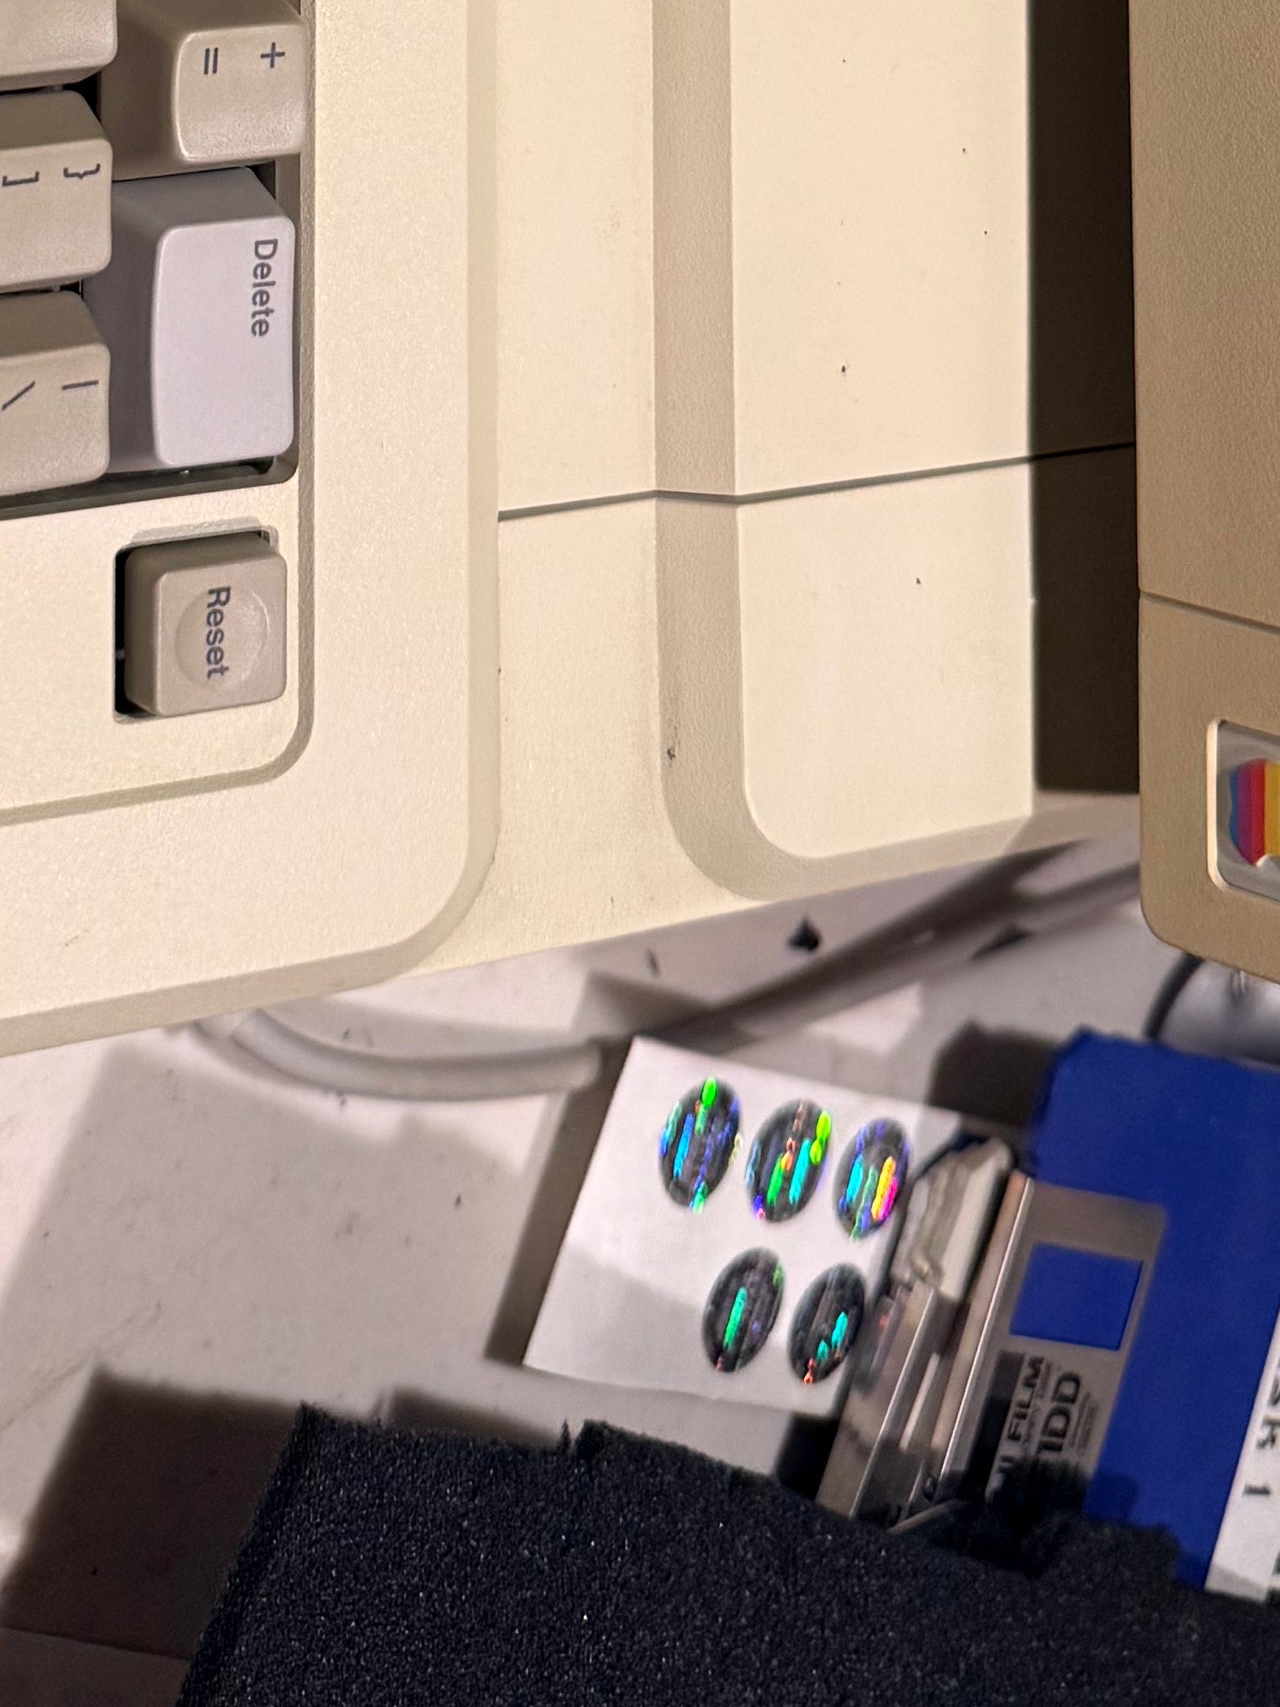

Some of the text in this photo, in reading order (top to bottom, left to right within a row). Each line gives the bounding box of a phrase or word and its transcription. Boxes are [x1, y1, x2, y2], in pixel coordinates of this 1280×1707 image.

[204, 47, 218, 75] =
[260, 42, 285, 68] +
[2, 171, 39, 187] ]
[63, 164, 100, 179] }
[251, 239, 278, 336] Delete
[206, 586, 231, 679] Reset
